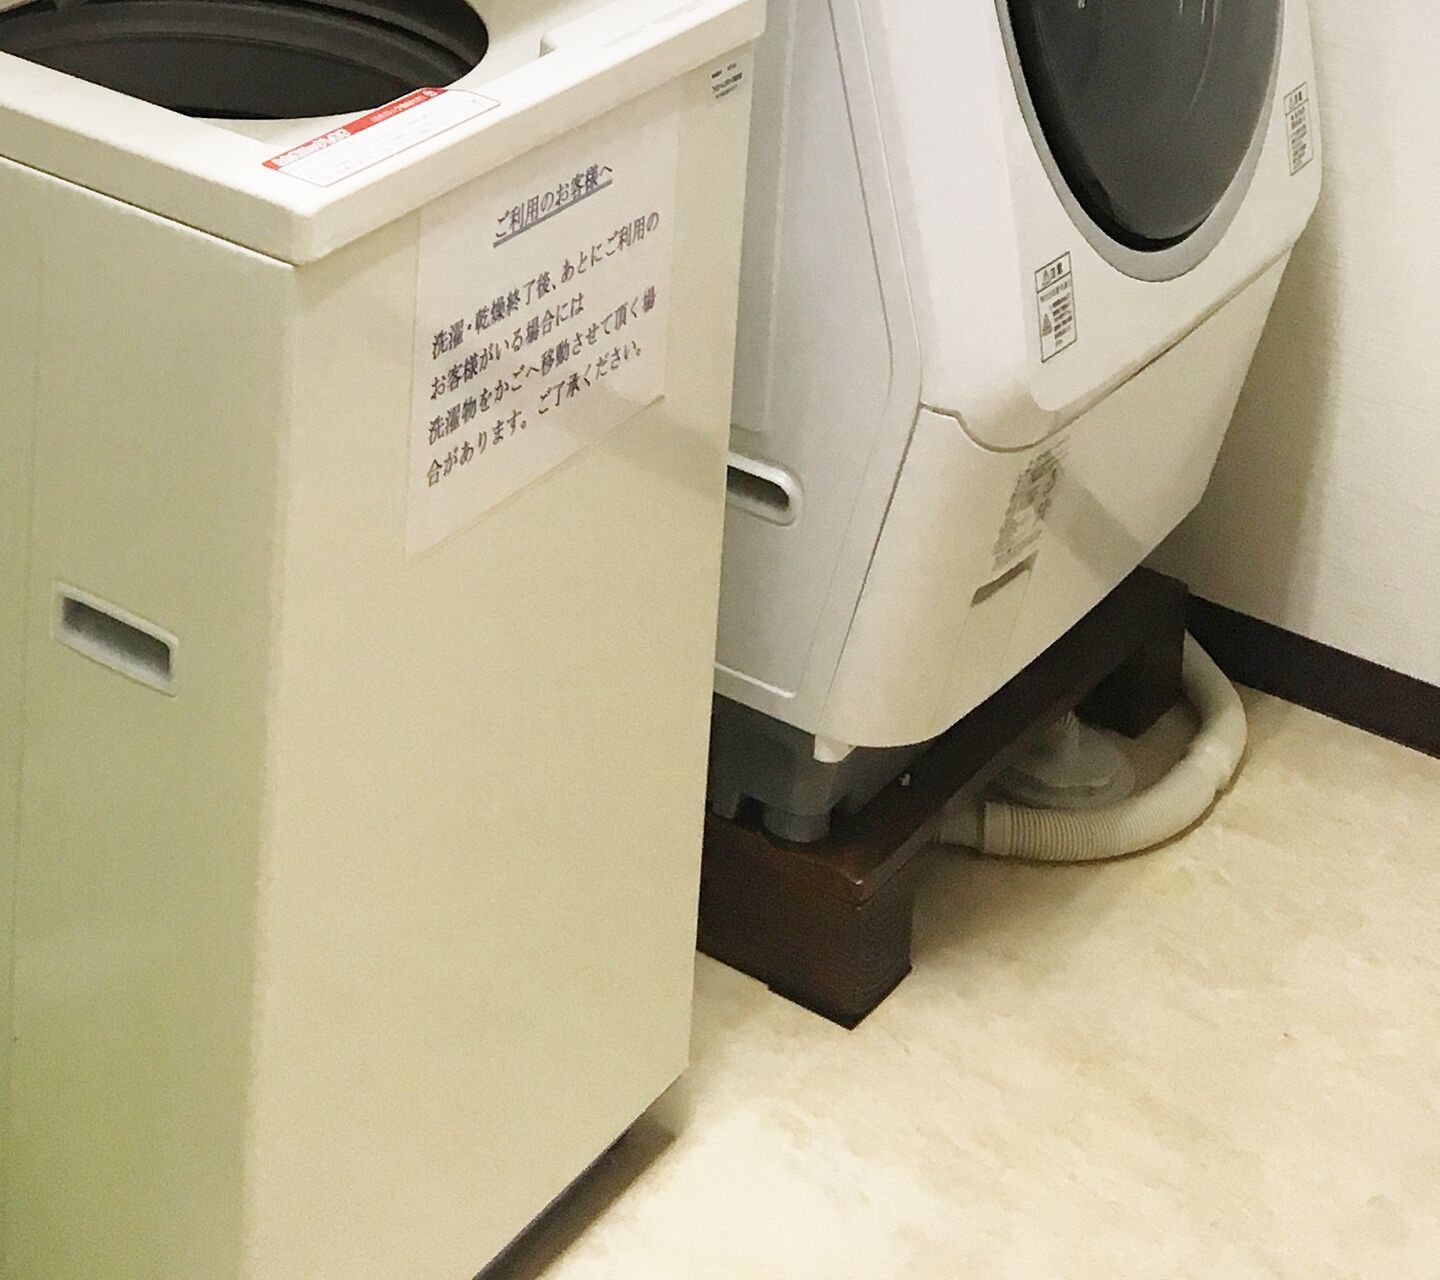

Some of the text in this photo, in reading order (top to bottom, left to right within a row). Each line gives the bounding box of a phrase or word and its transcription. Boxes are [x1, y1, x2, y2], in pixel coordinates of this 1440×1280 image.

[495, 163, 613, 239] ご利用のお客様へ
[431, 291, 586, 401] お客様がいる場合には
[432, 210, 660, 360] 洗濯・乾燥終了後、あとにご利用の
[426, 344, 643, 488] 合があります。ご了承ください。
[428, 285, 657, 447] 洗濯物をかごへ移動させて頂く場
